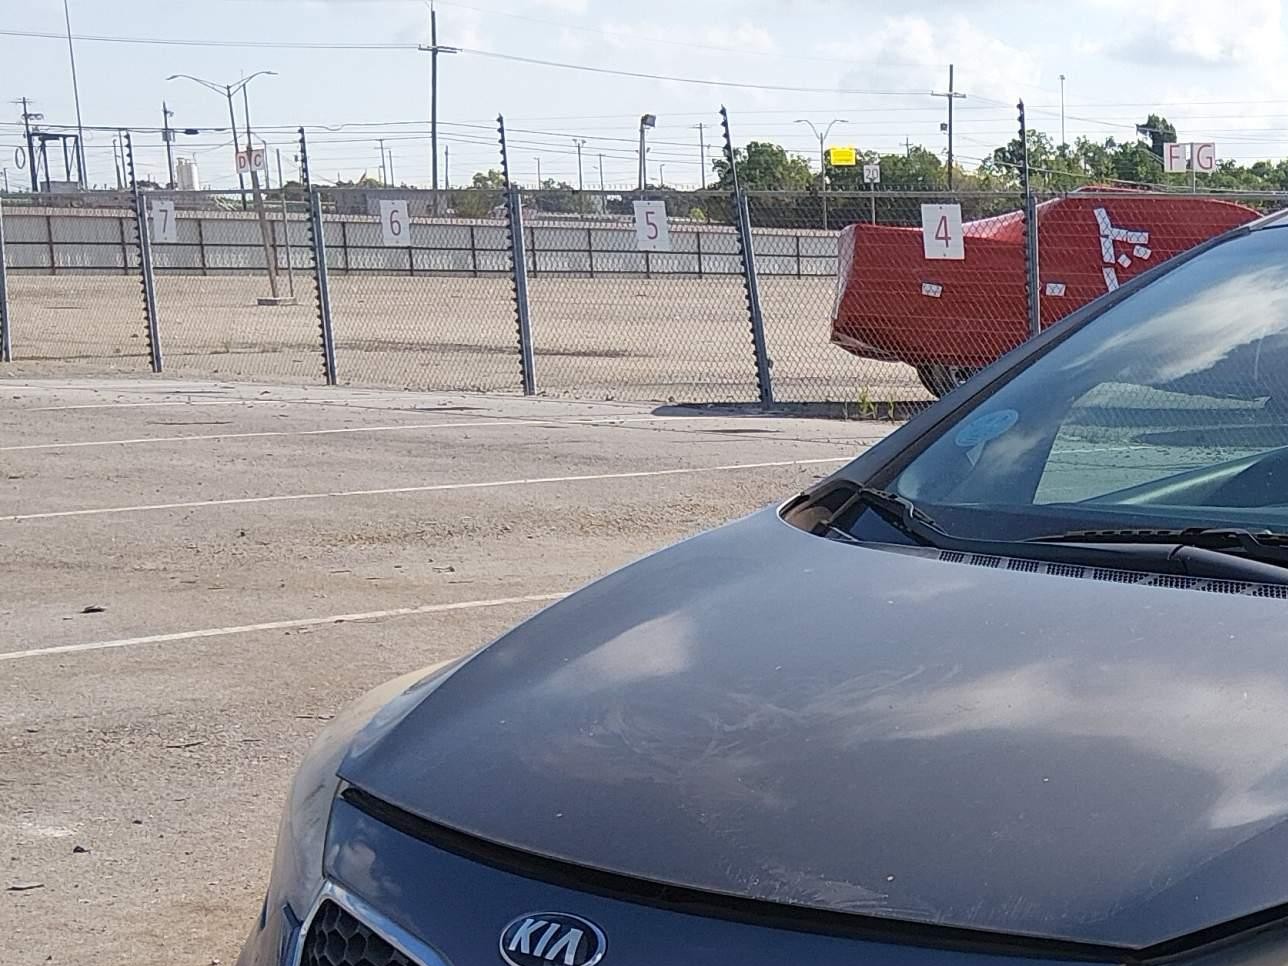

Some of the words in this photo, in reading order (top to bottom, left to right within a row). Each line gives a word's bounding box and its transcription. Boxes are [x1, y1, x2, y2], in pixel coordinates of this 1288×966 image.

[238, 156, 246, 169] D
[253, 154, 262, 167] C
[1169, 144, 1180, 171] F
[1197, 144, 1213, 170] G
[159, 209, 168, 233] 7
[389, 209, 401, 236] 6
[645, 211, 658, 240] 5
[934, 215, 952, 248] 4
[508, 918, 584, 966] KIA
